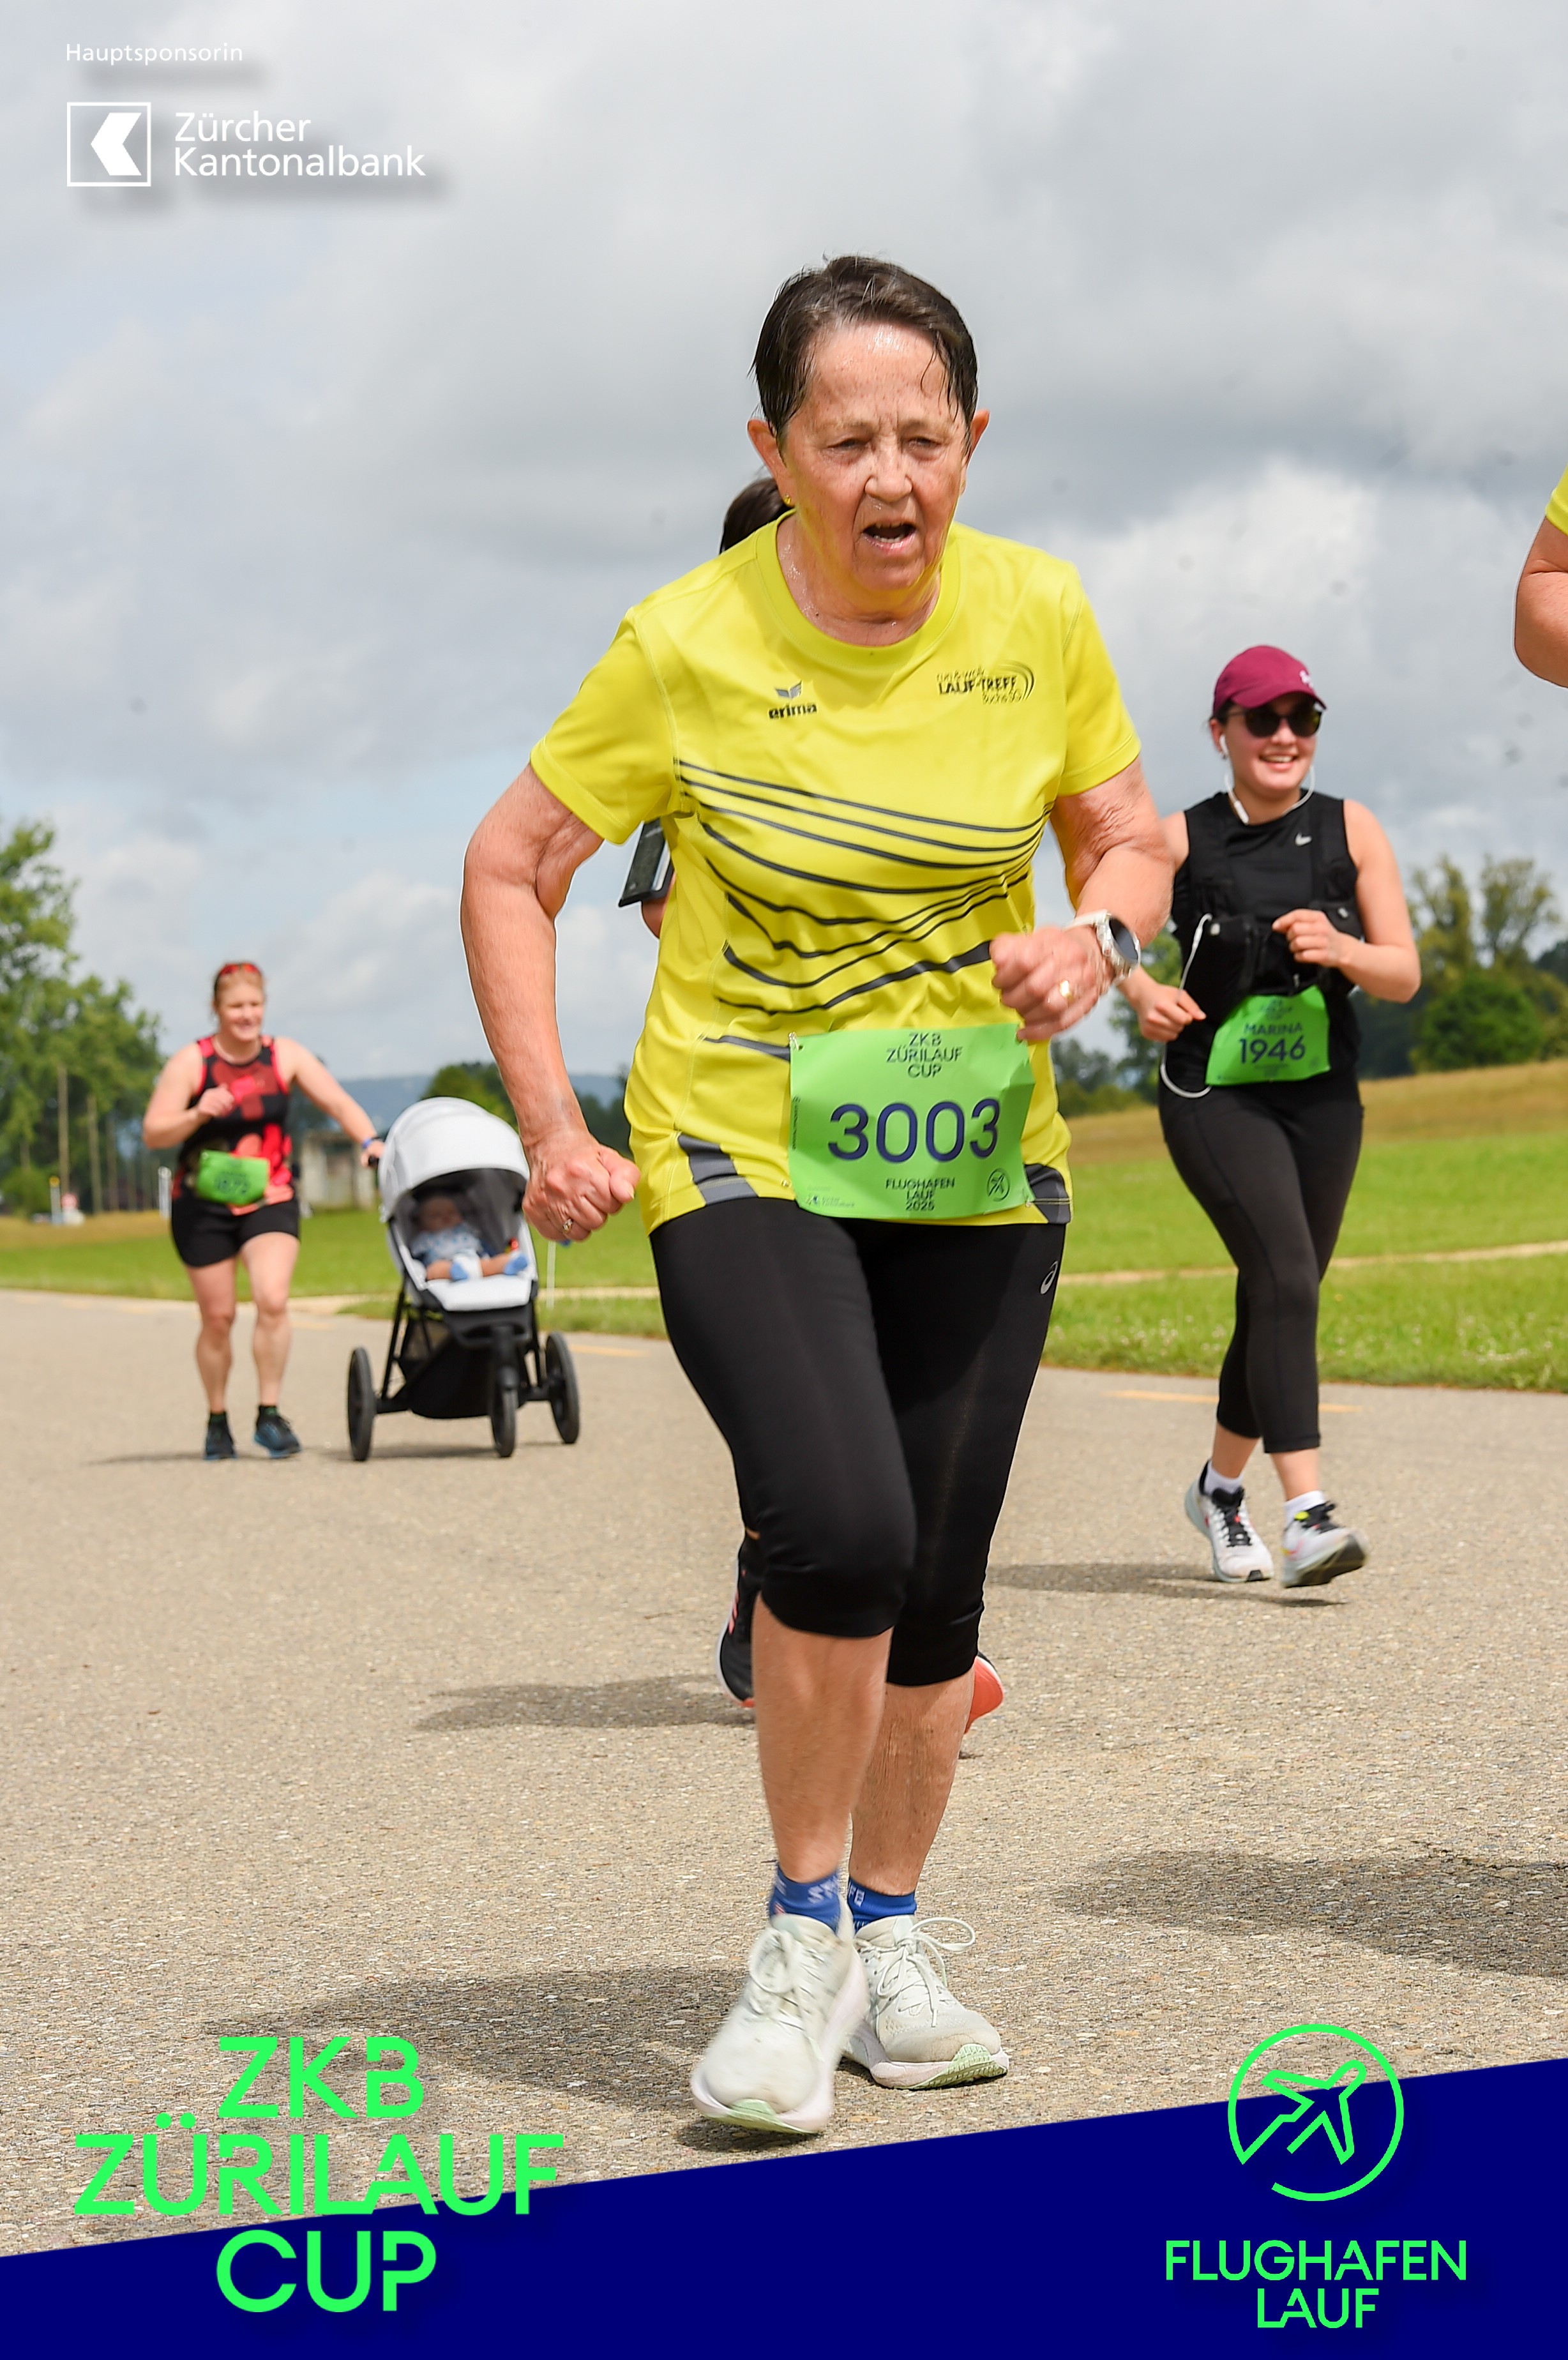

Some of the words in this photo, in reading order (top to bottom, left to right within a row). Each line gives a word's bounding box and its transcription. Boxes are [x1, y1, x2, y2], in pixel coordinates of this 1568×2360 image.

[768, 704, 817, 719] erima
[1244, 1022, 1303, 1036] MARINA
[909, 1032, 942, 1047] ZKB
[886, 1045, 963, 1063] ZÜRILAUF
[1239, 1034, 1306, 1064] 1946
[907, 1063, 942, 1078] CUP
[828, 1098, 1000, 1163] 3003
[886, 1177, 955, 1189] FLUGHAFEN
[907, 1190, 935, 1201] LAUF
[906, 1200, 935, 1211] 2025
